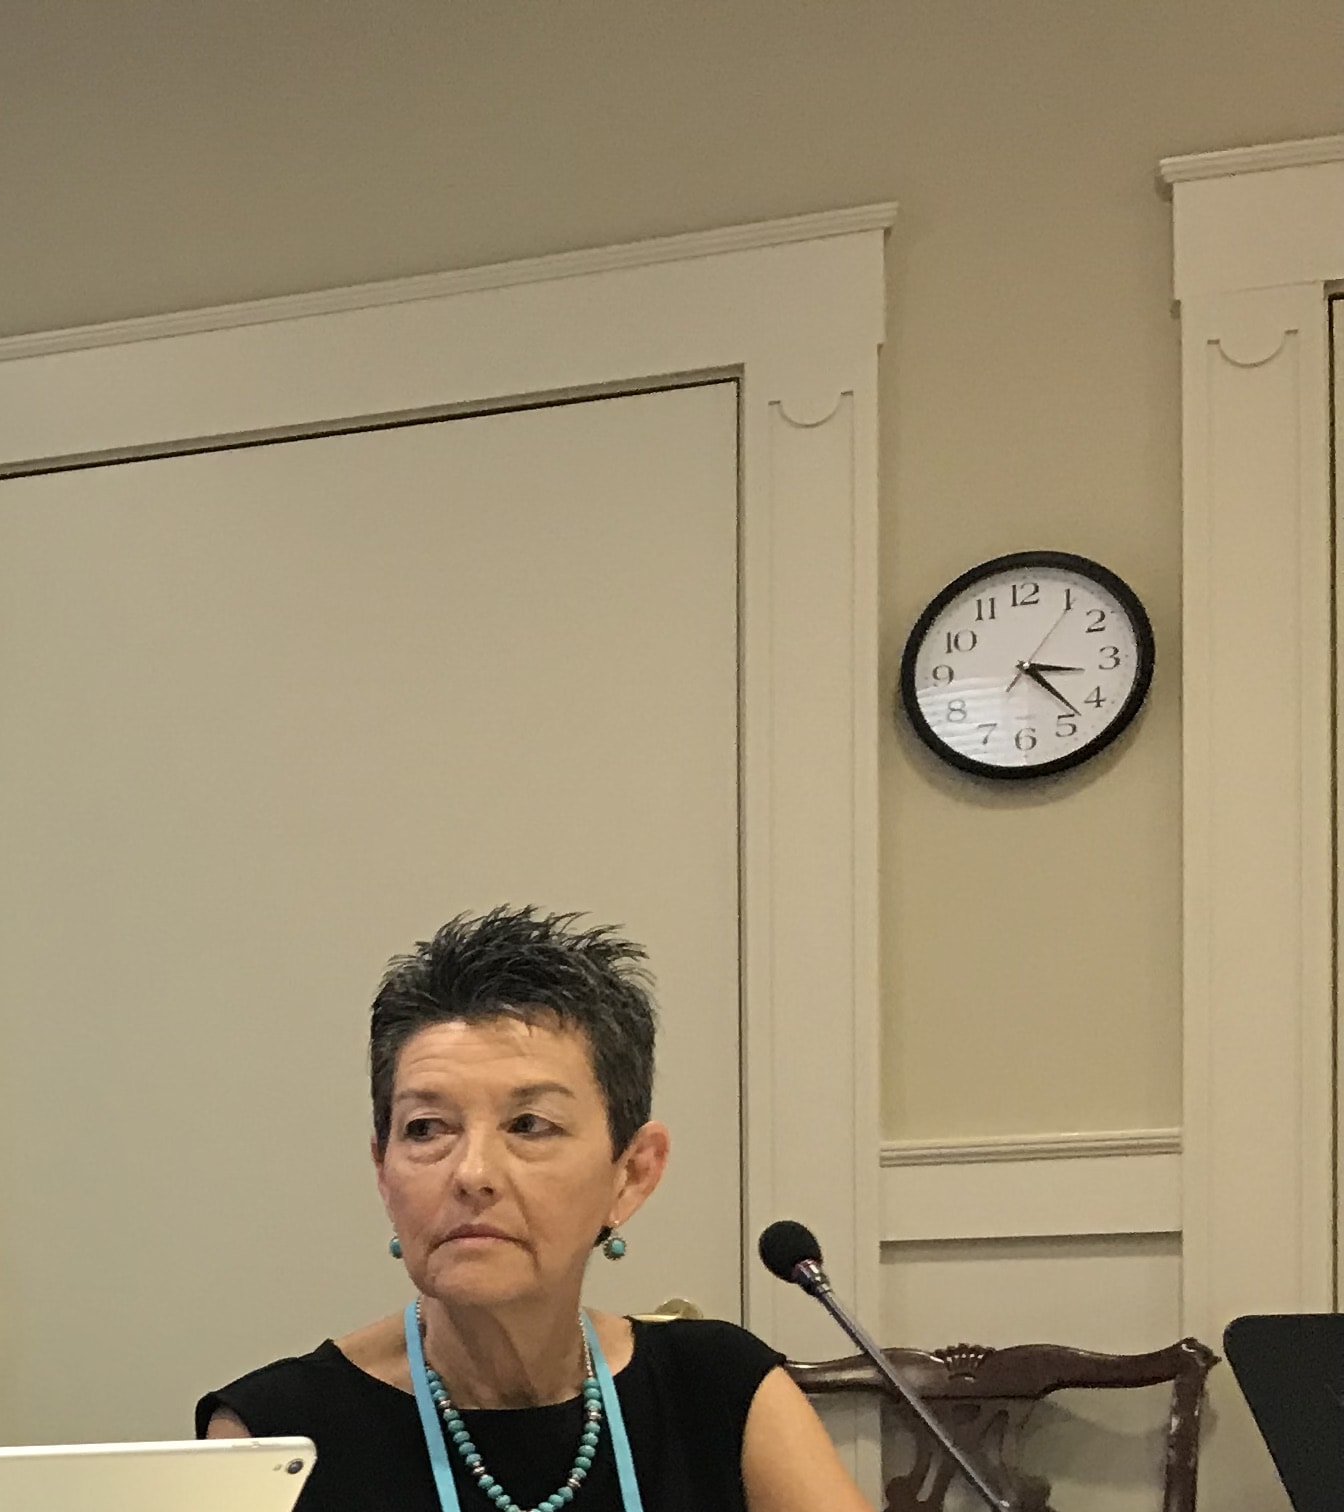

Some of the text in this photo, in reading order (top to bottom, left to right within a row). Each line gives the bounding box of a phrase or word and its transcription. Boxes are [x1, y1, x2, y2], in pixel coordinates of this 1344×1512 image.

[1010, 582, 1040, 608] 12
[975, 597, 997, 621] 11
[1085, 608, 1106, 633] 2
[945, 630, 978, 654] 10
[1098, 646, 1121, 670] 3
[932, 664, 955, 687] 9
[1084, 686, 1107, 708] 4
[946, 699, 967, 723] 8
[978, 723, 998, 745] 7
[1055, 713, 1077, 738] 5
[1014, 728, 1037, 751] 6
